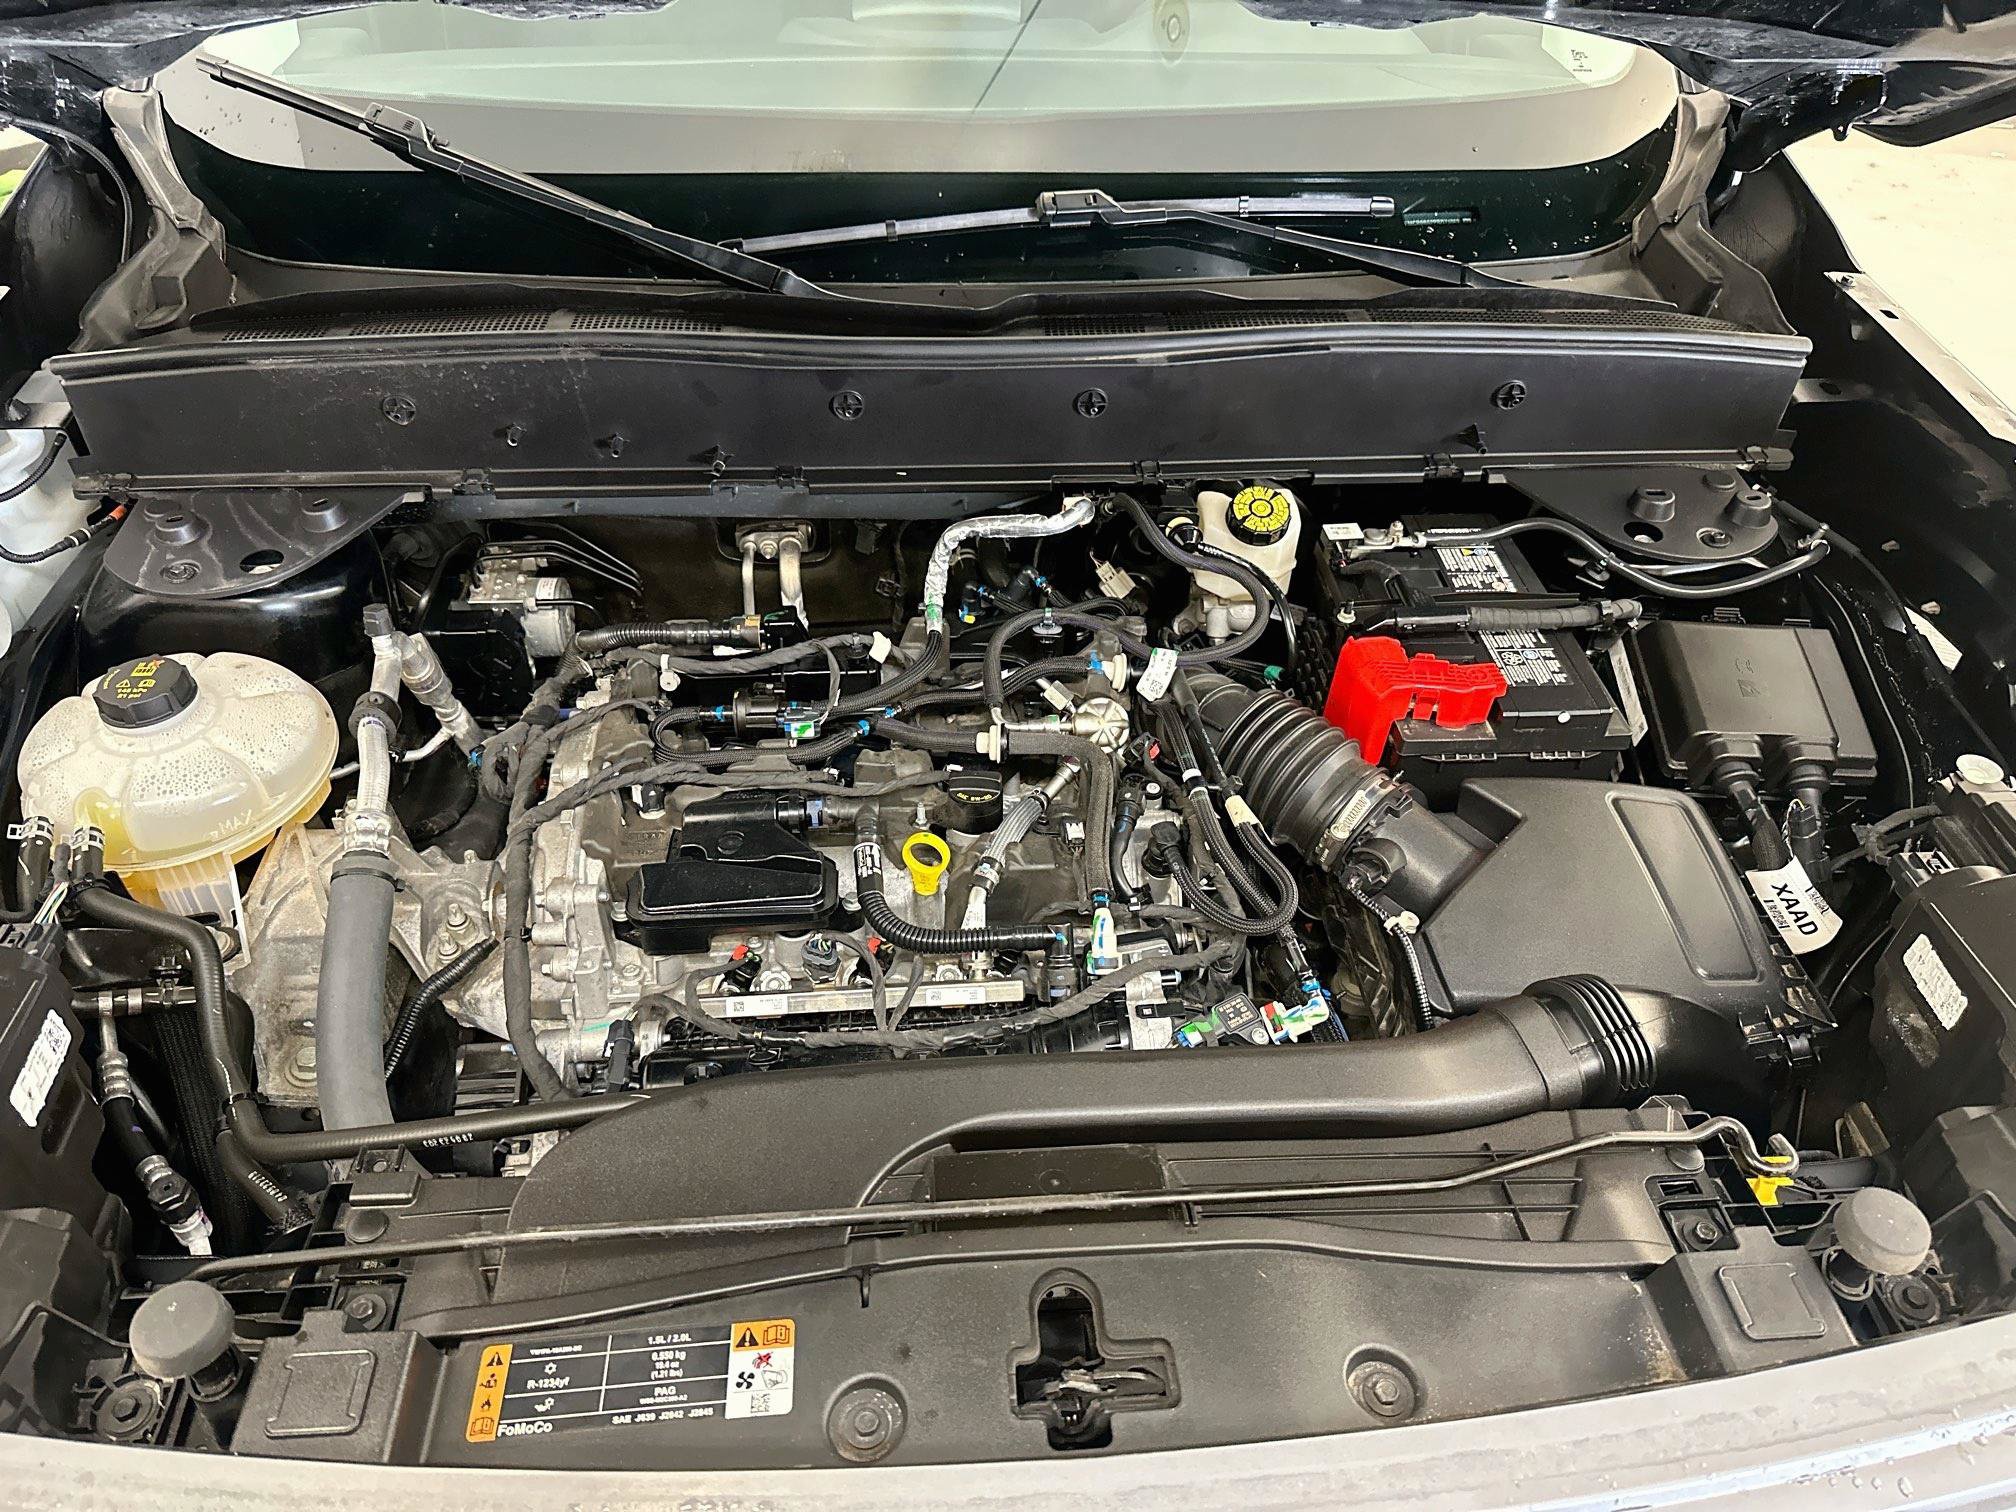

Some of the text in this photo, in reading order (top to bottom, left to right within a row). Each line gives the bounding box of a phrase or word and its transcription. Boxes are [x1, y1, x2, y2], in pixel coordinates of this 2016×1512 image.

[218, 808, 253, 836] MAX
[1770, 883, 1819, 935] XAAD
[672, 1333, 692, 1343] 2.0L
[675, 1350, 687, 1361] kg
[526, 1376, 570, 1390] R-1234yf
[654, 1385, 676, 1396] PAG
[612, 1414, 632, 1424] SAE
[497, 1421, 553, 1437] FoMoCo
